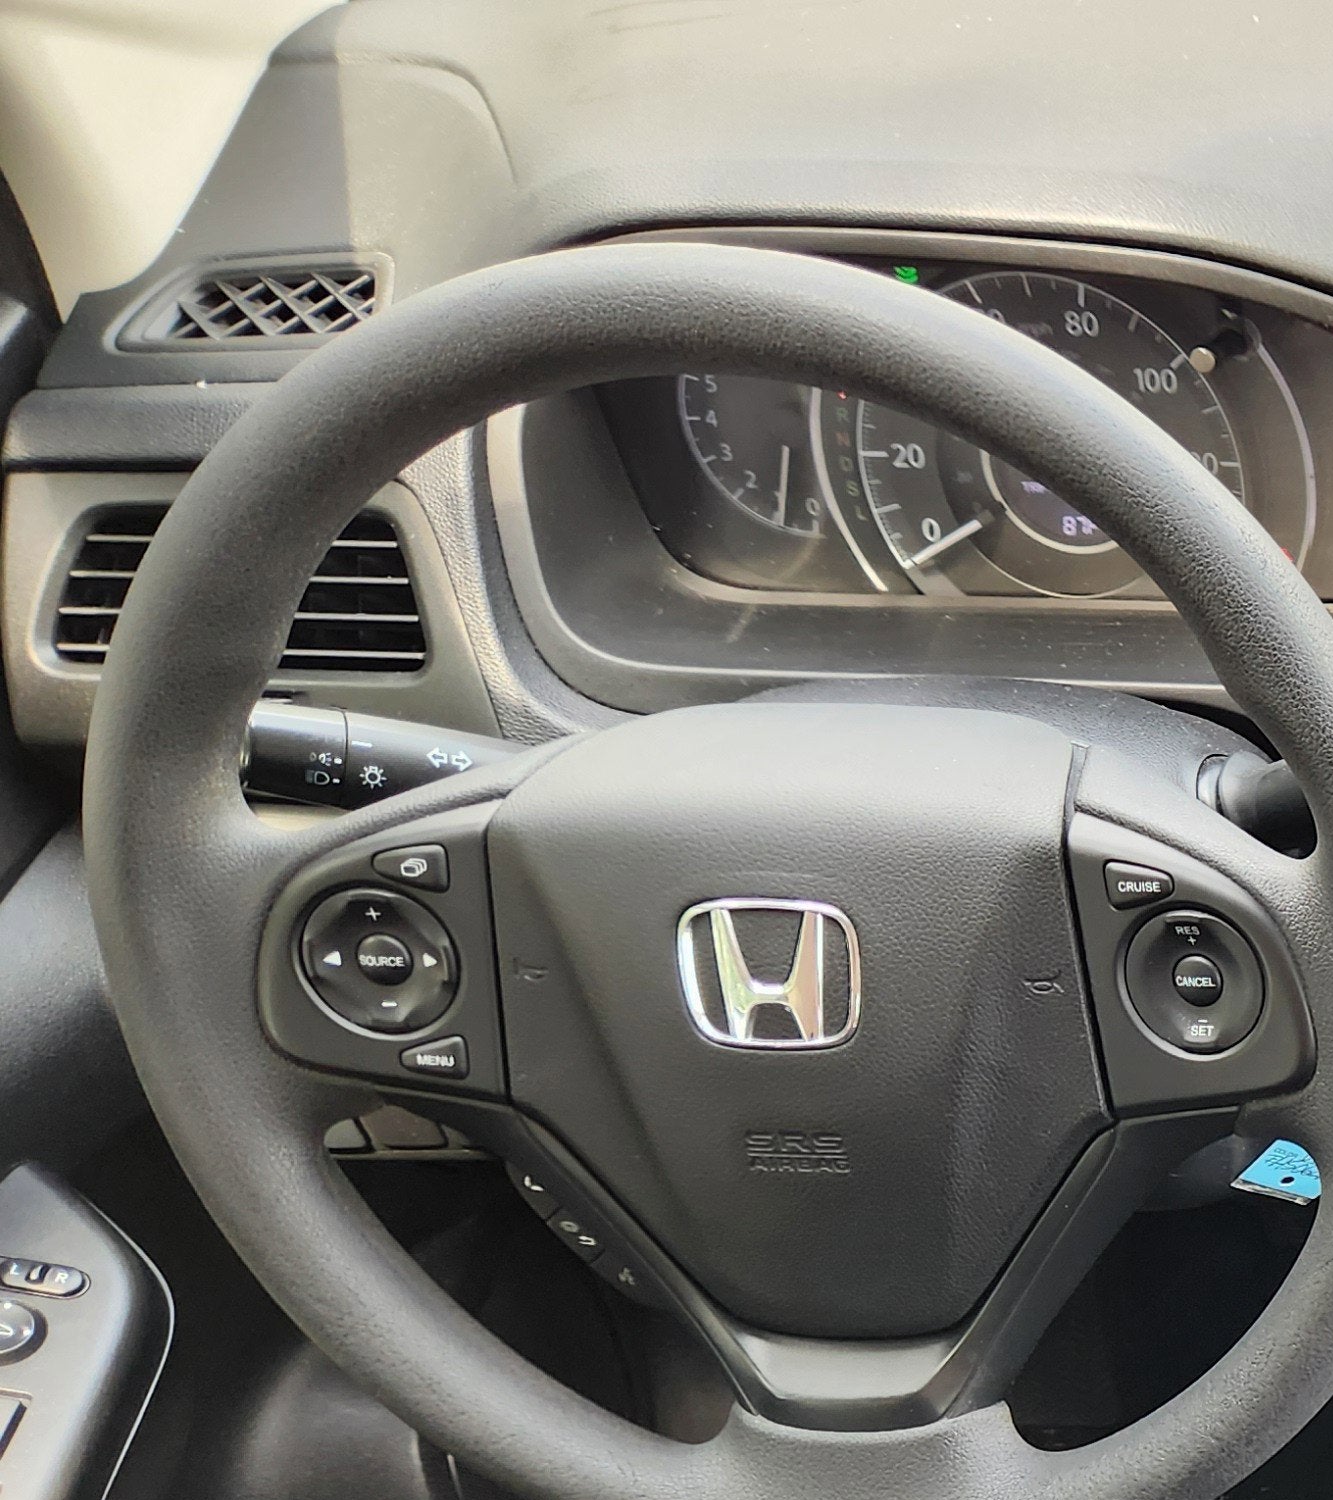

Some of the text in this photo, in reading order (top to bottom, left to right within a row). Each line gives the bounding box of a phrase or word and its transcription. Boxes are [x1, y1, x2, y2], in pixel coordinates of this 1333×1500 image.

[1064, 311, 1099, 337] 80
[704, 374, 718, 393] 5
[1133, 368, 1178, 394] 100
[705, 410, 718, 428] 4
[719, 443, 733, 462] 3
[890, 443, 926, 469] 20
[743, 469, 758, 489] 2
[805, 498, 820, 516] 0
[921, 517, 941, 542] 0
[1117, 881, 1161, 893] CRUISE
[1175, 926, 1200, 936] RES
[358, 953, 405, 968] SOURCE
[1175, 975, 1216, 988] CANCEL
[1190, 1025, 1214, 1037] SET
[416, 1053, 455, 1067] MENU
[745, 1134, 845, 1153] SRS
[749, 1158, 851, 1173] AIRBAG
[54, 1271, 69, 1284] R
